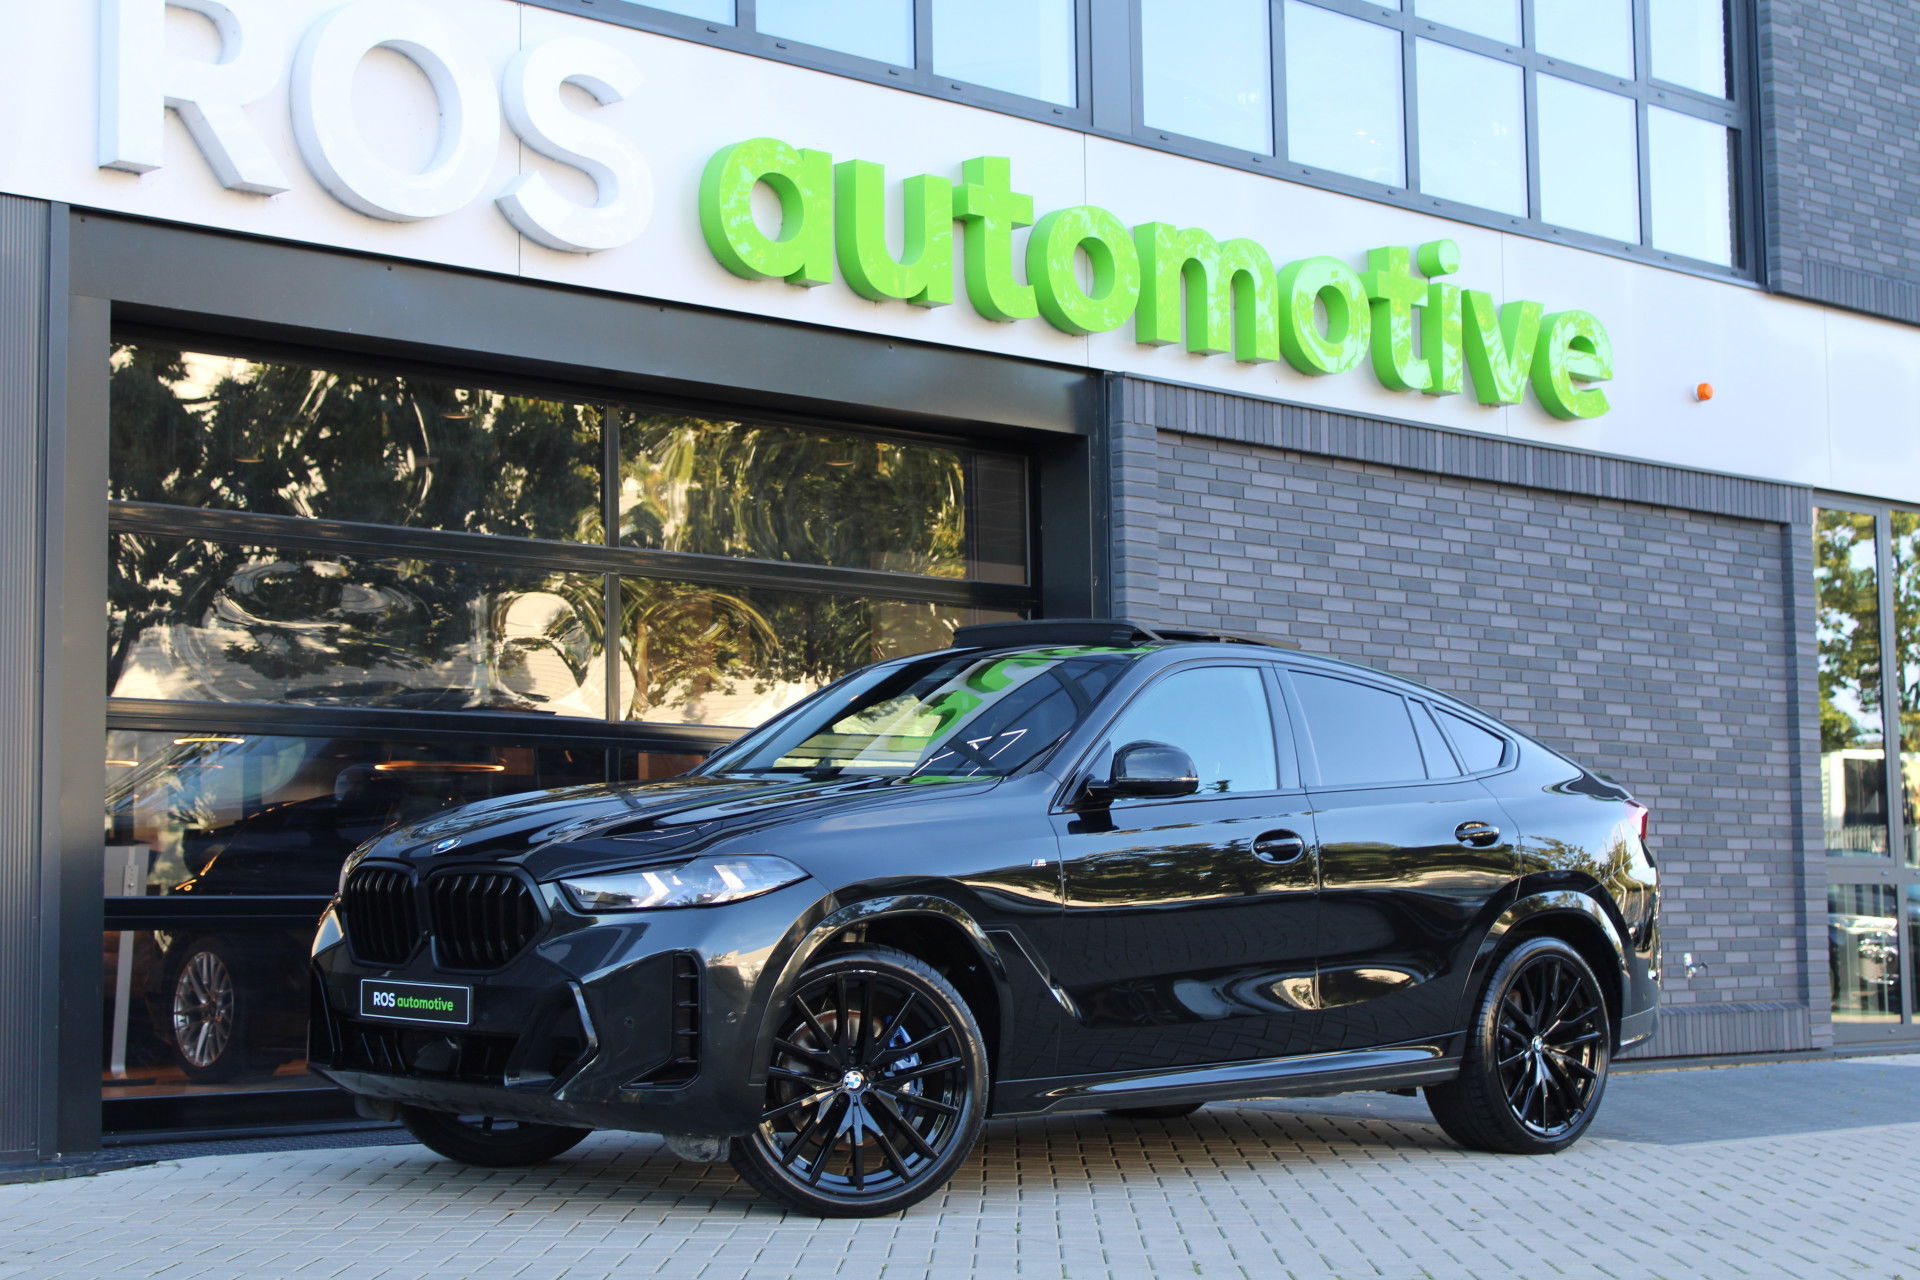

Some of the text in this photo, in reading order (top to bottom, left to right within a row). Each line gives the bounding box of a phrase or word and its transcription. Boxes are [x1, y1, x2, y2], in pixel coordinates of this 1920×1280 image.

[98, 0, 1614, 421] ROS automotive
[373, 991, 454, 1012] ROS automotive
